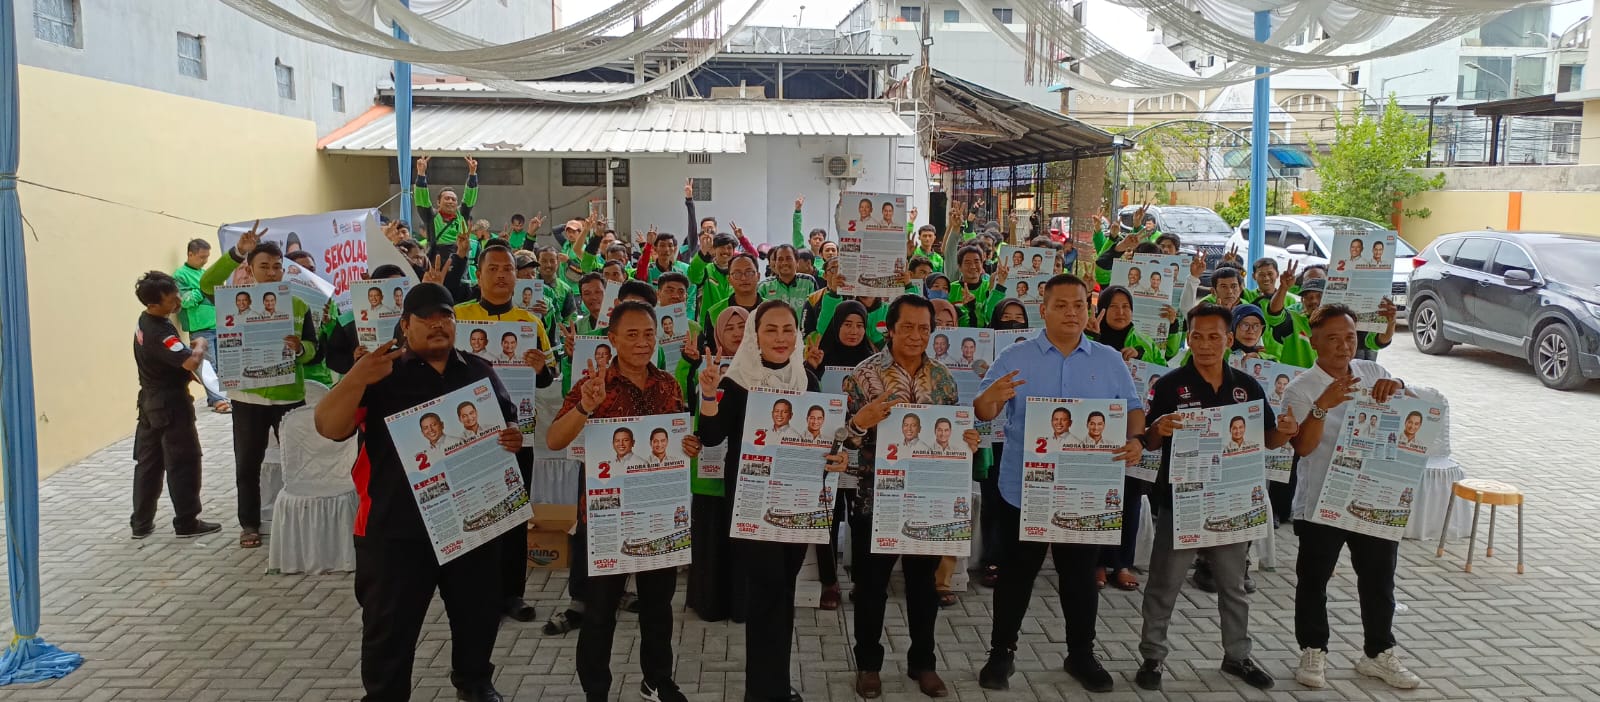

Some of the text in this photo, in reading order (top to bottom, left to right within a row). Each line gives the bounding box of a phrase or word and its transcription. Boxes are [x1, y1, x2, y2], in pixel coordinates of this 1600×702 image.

[225, 316, 234, 327] 2
[754, 429, 767, 446] 2
[887, 444, 898, 460] 2
[1036, 438, 1047, 453] 2
[416, 452, 431, 470] 2
[599, 463, 610, 478] 2
